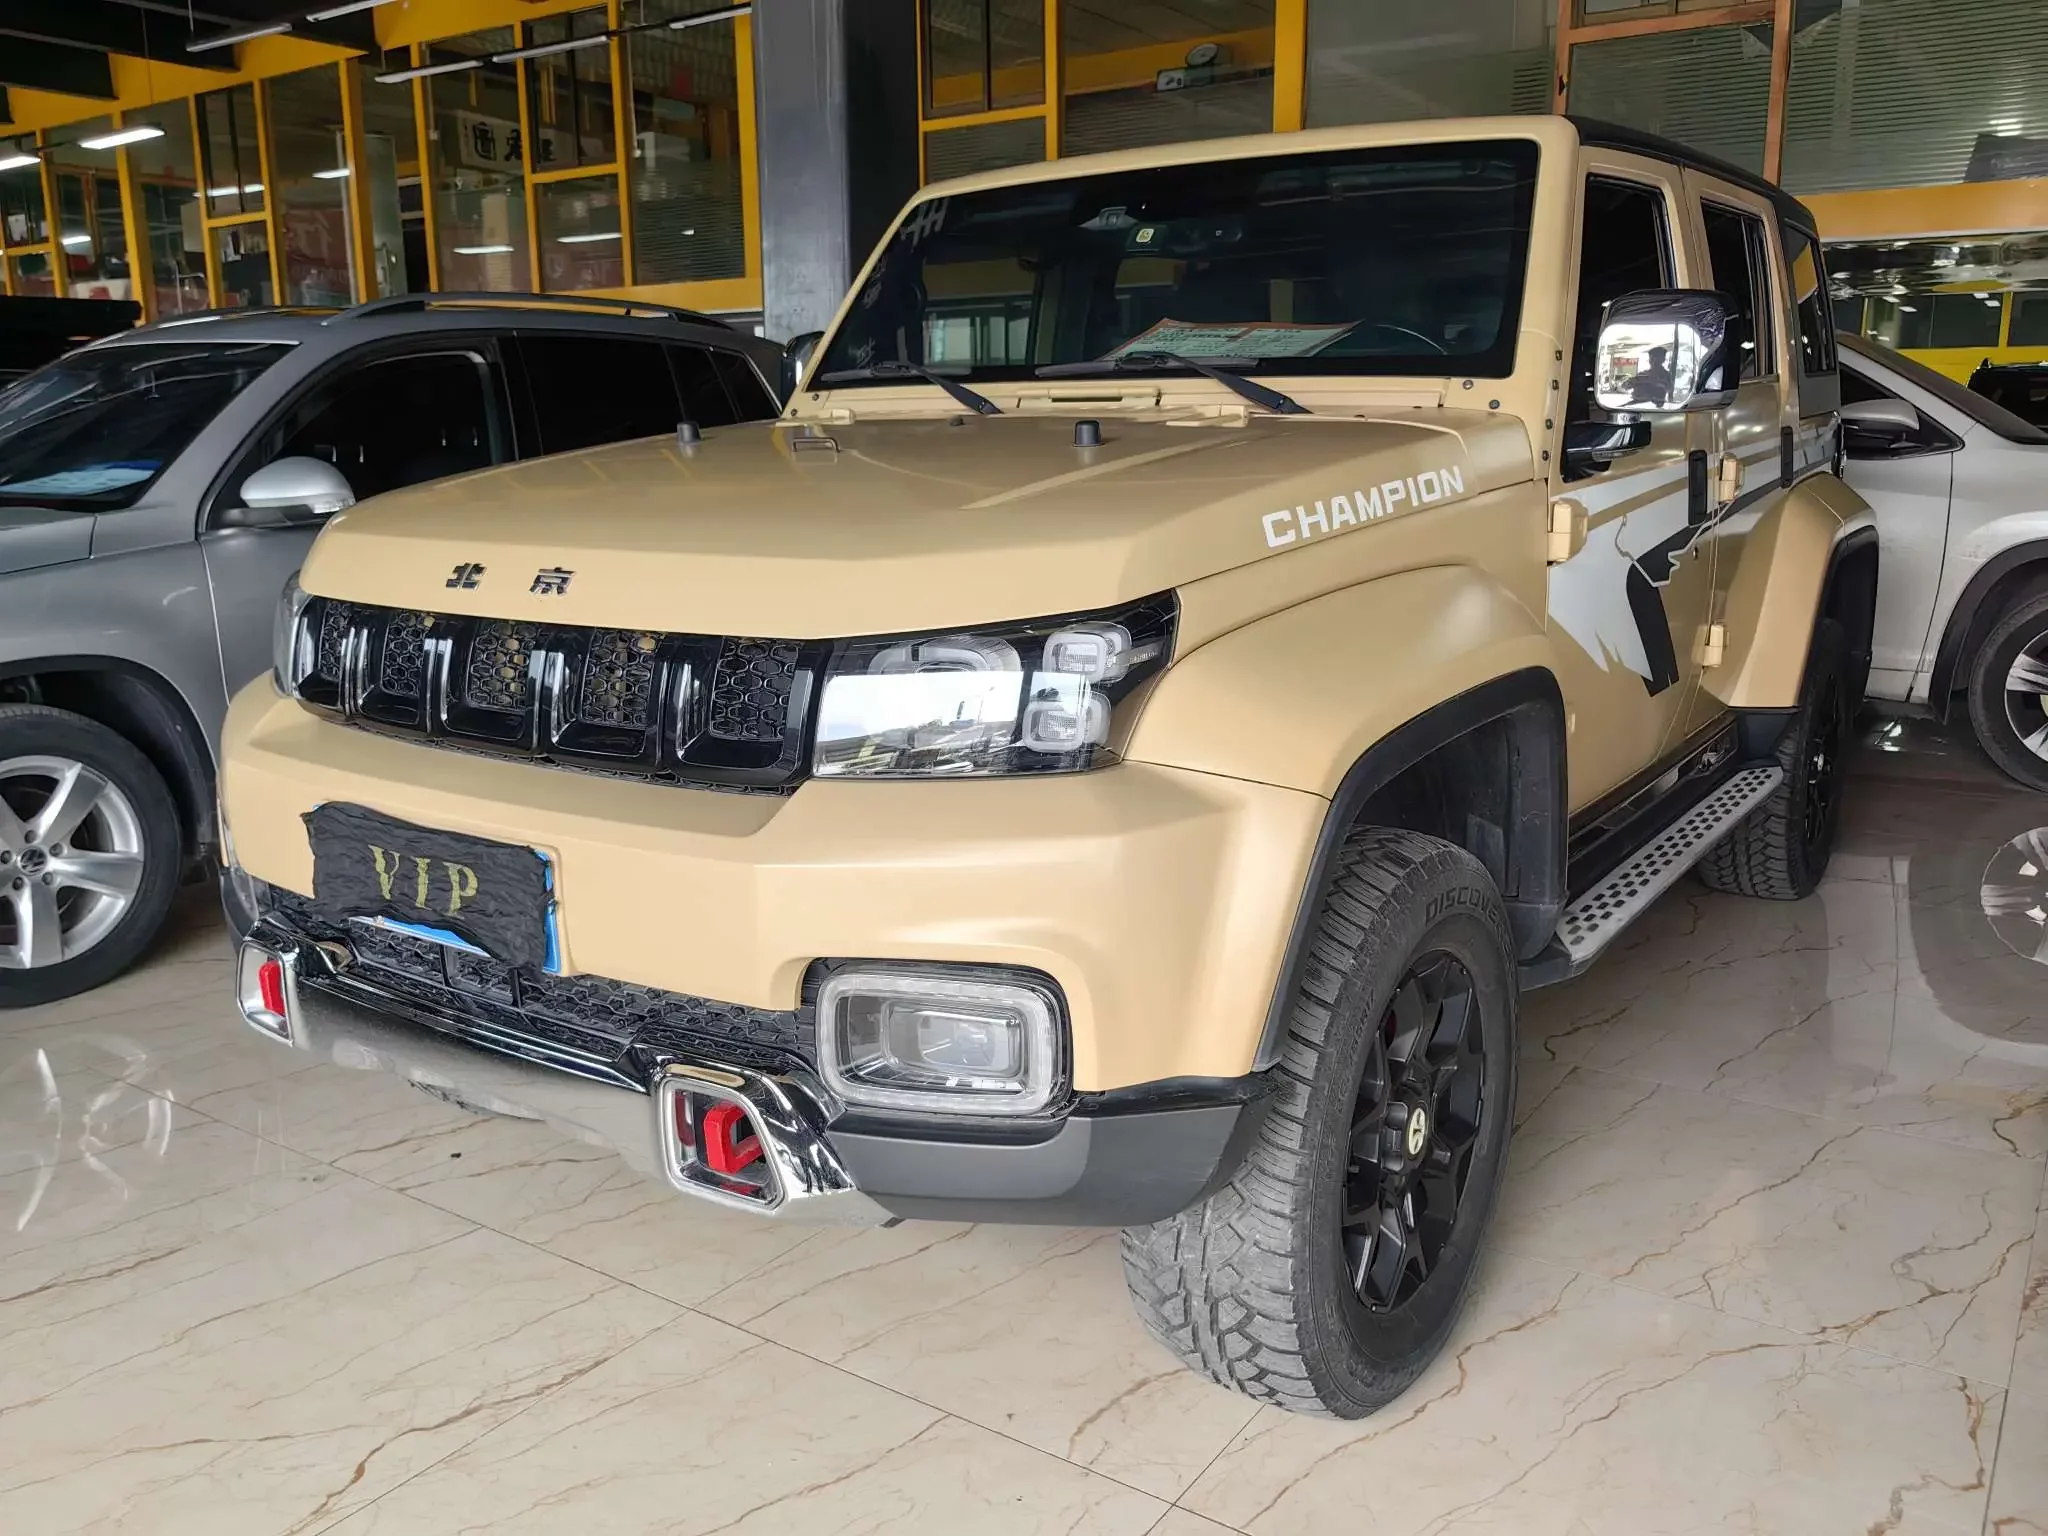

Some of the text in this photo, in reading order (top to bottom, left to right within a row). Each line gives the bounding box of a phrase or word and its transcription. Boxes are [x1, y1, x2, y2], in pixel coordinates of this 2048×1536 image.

[1262, 466, 1464, 548] CHAMPION
[445, 562, 577, 596] 北京
[368, 844, 478, 920] VIP
